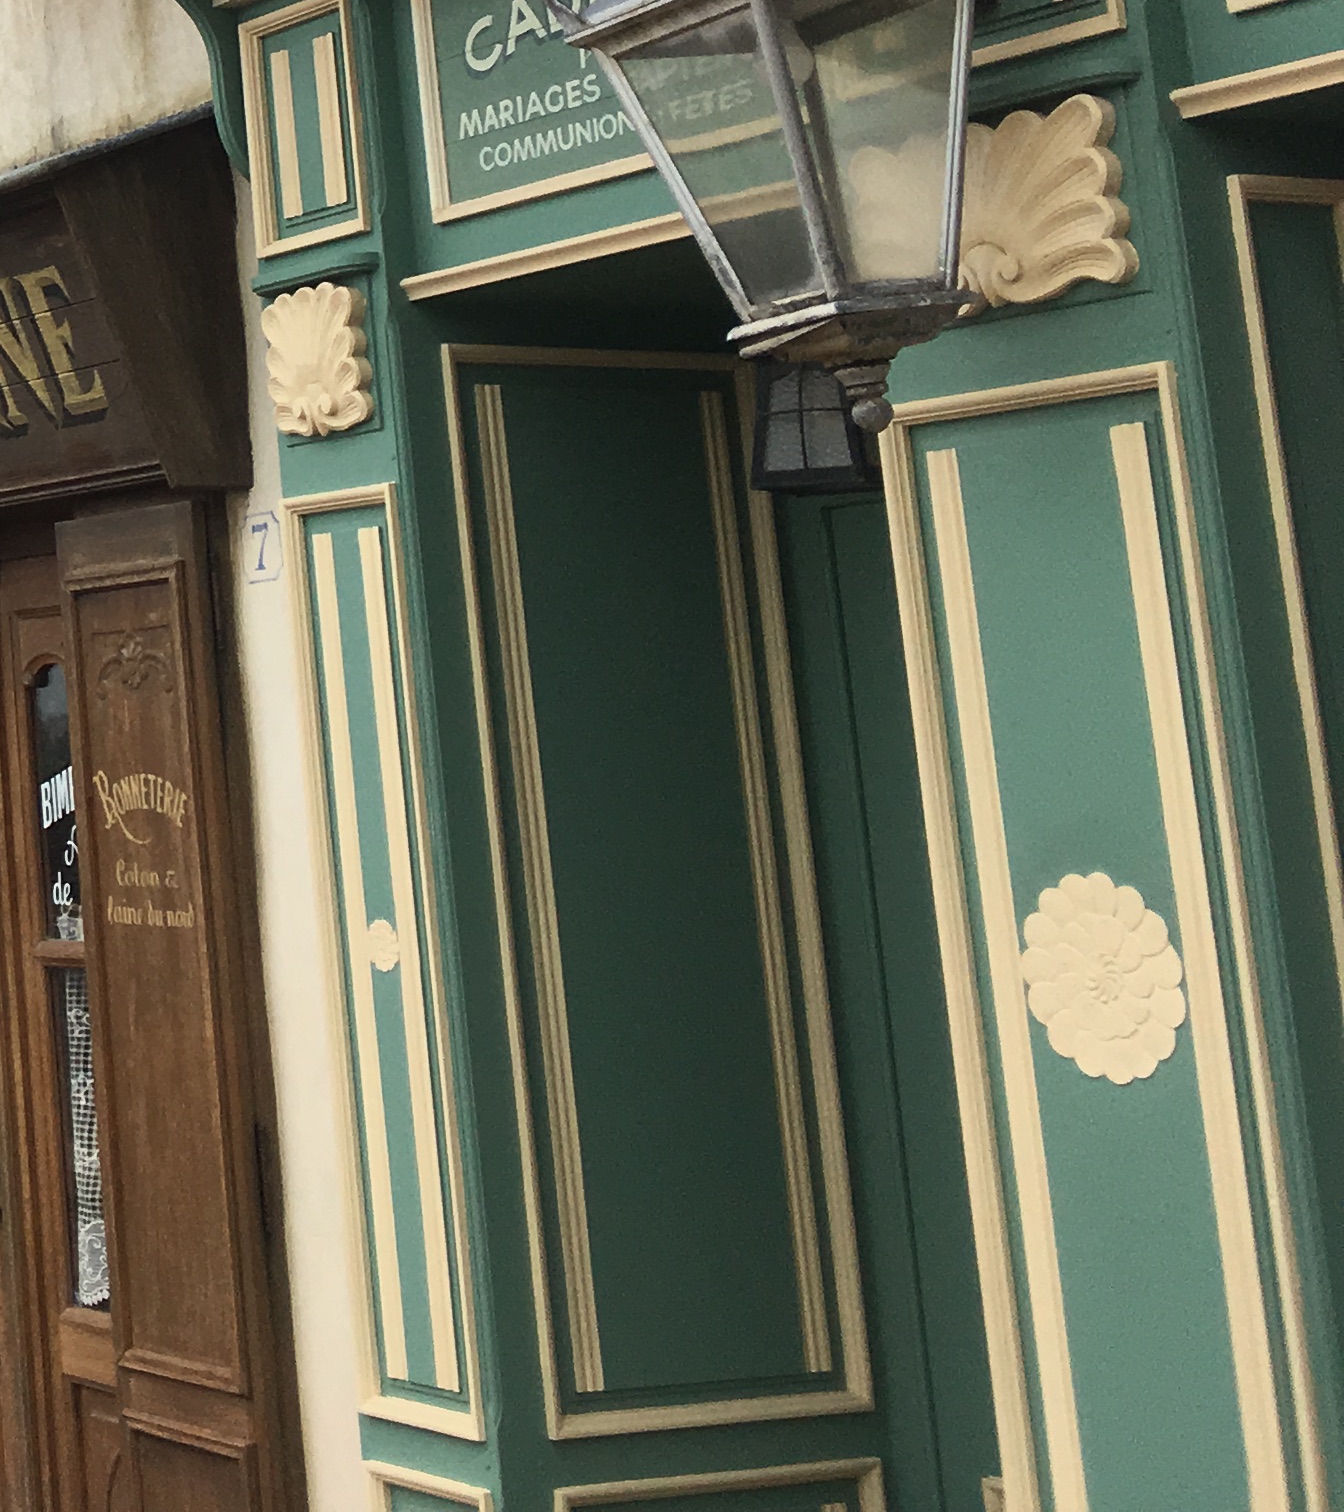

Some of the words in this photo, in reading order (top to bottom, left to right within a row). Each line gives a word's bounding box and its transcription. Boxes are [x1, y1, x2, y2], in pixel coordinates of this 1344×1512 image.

[459, 74, 602, 140] MARIAGES
[479, 110, 636, 172] COMMUNION
[251, 522, 268, 571] 7
[93, 770, 187, 845] BONNETERIE
[52, 871, 74, 906] de
